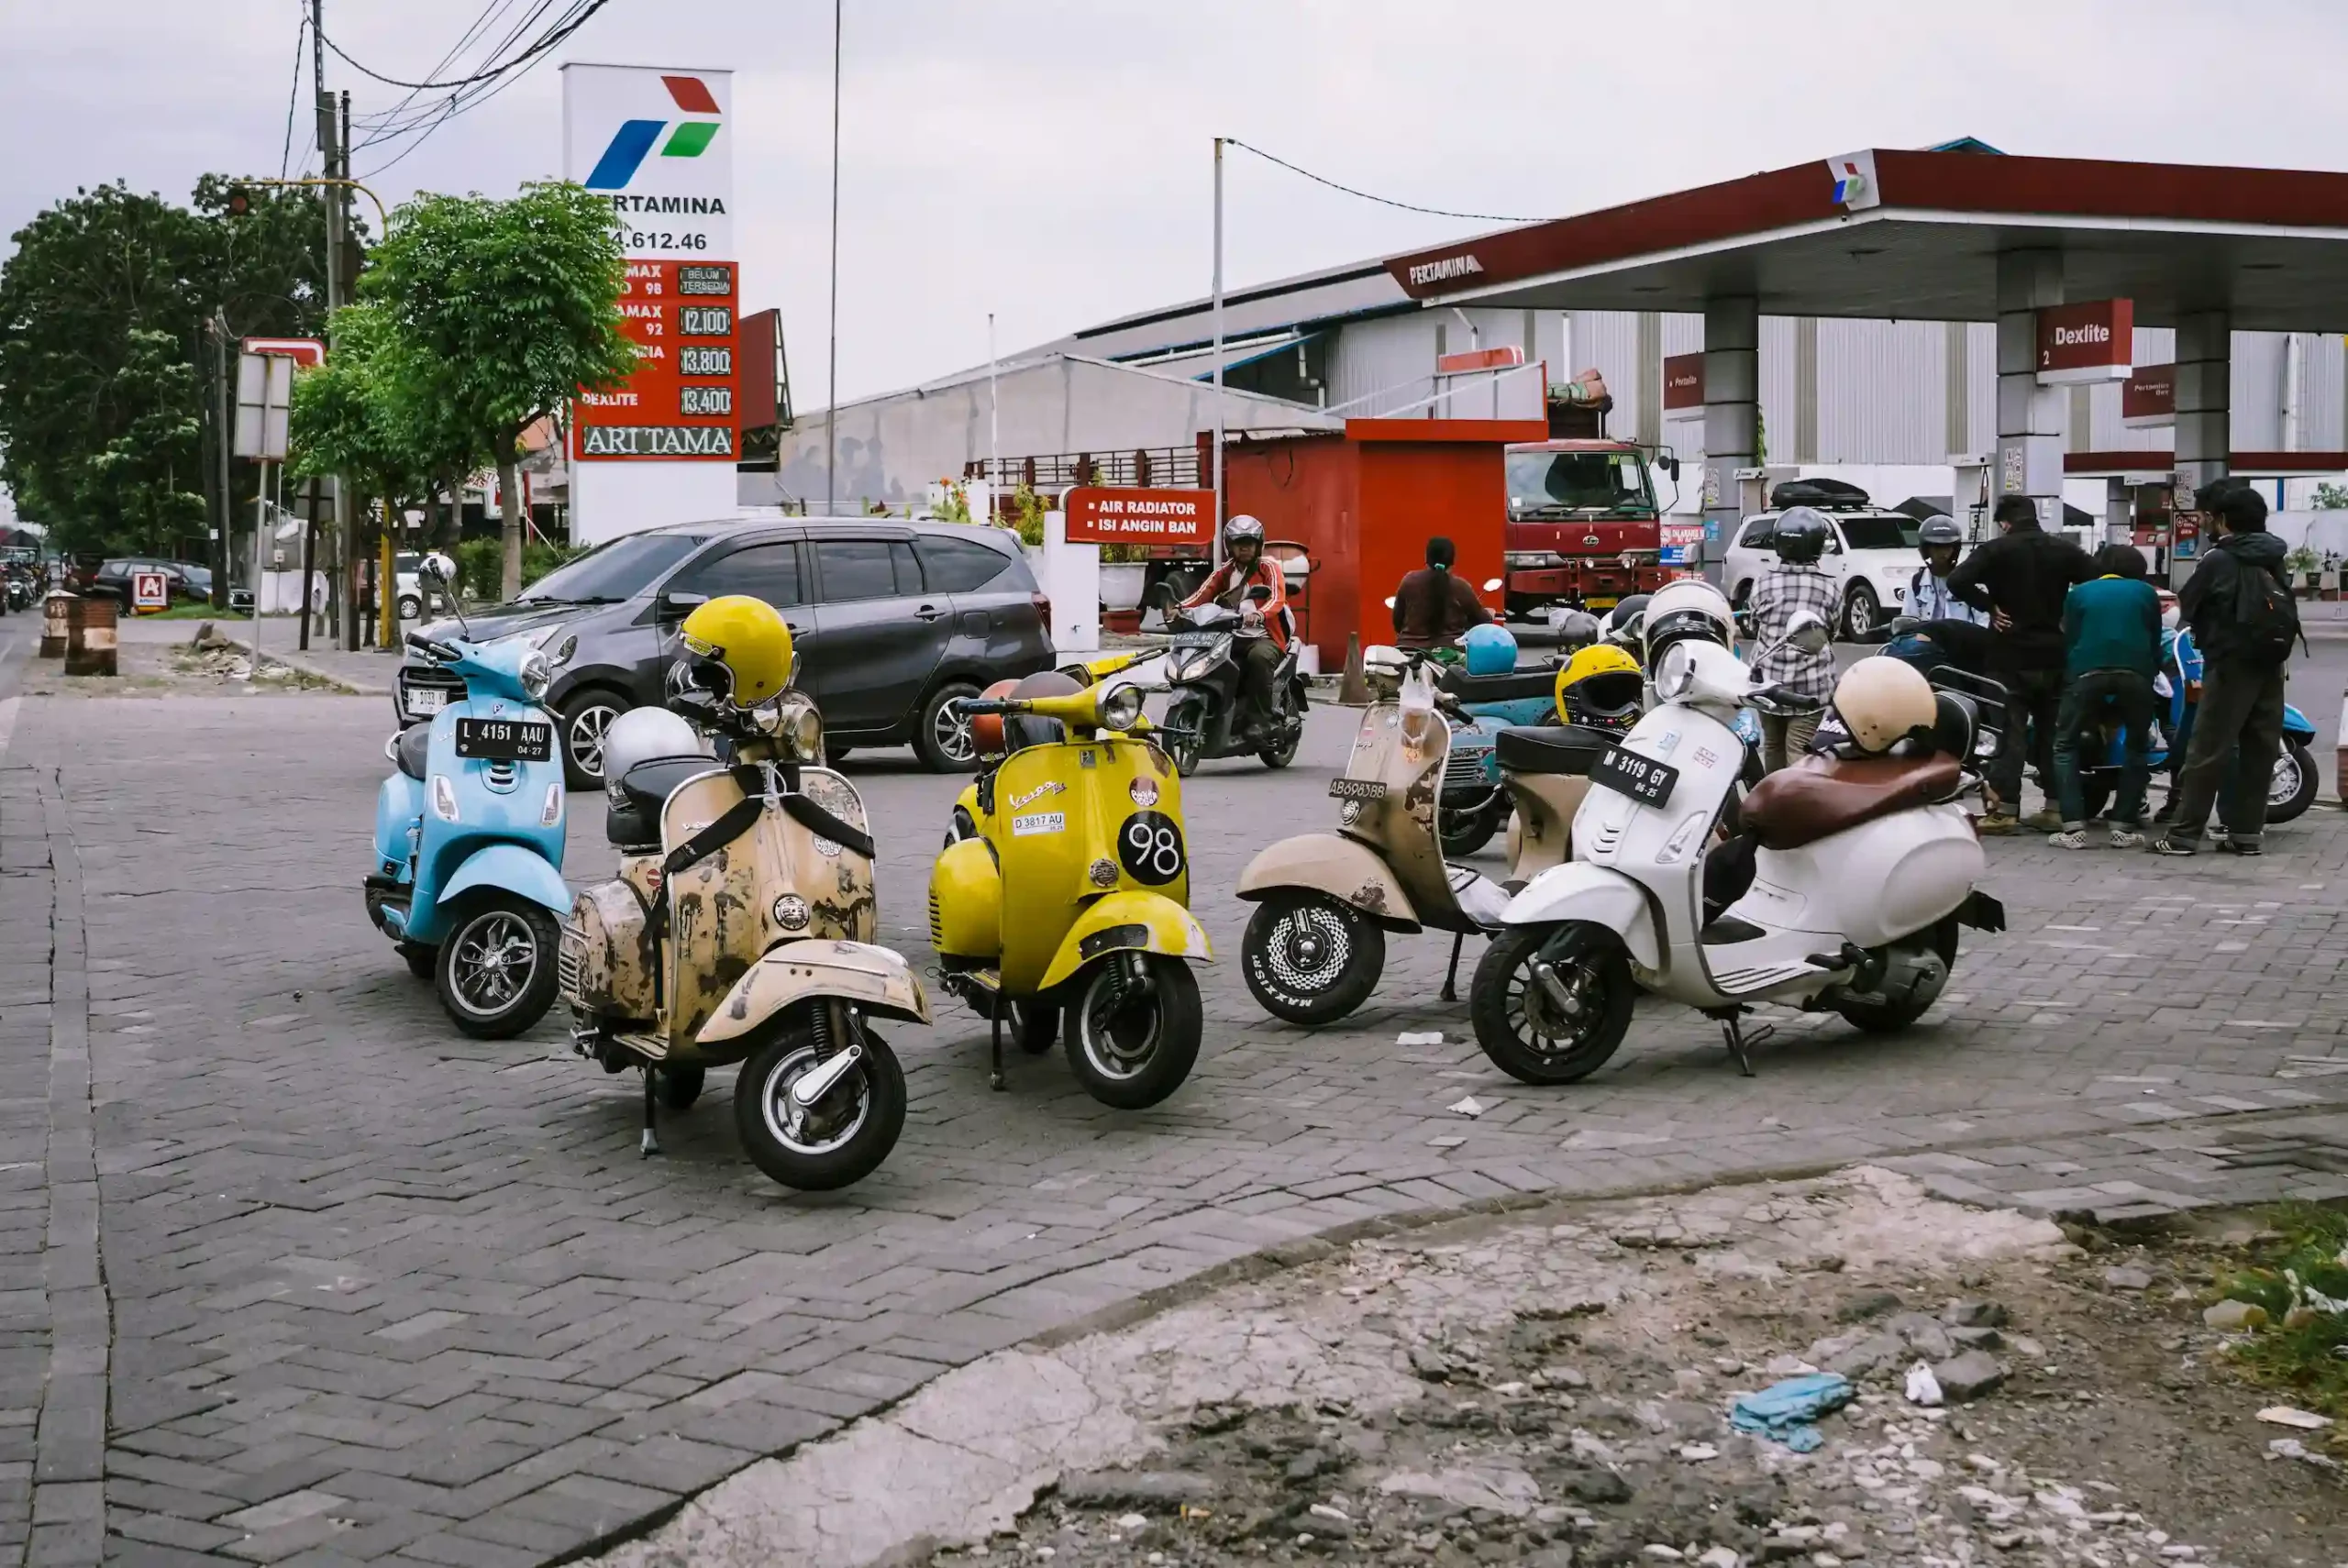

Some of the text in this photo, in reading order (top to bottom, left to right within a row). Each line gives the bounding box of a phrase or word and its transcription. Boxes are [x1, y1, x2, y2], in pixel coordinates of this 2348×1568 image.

[587, 194, 725, 215] RTAMINA
[600, 231, 707, 250] 4.612.46
[688, 271, 719, 281] BELUM
[1409, 255, 1484, 285] PERTAMINA
[645, 282, 662, 295] 98
[682, 281, 728, 291] TERSEDIA
[646, 323, 663, 336] 92
[685, 311, 727, 333] 12.100
[2054, 324, 2110, 345] Dexlite
[683, 350, 730, 372] 13.800
[2043, 350, 2050, 365] 2
[581, 392, 638, 406] DEXLITE
[684, 390, 730, 412] 13.400
[585, 427, 732, 453] ARI TAMA
[1099, 500, 1196, 515] AIR RADIATOR
[1098, 518, 1197, 534] ISI ANGIN BAN
[463, 722, 471, 738] L
[482, 724, 511, 741] 4151
[521, 726, 545, 743] AAU
[1603, 750, 1667, 787] M 3119 GY
[1635, 782, 1658, 798] 06-25
[1015, 814, 1062, 829] D 3817 AU
[1129, 823, 1179, 875] 98
[1255, 969, 1313, 1007] MAXXIS
